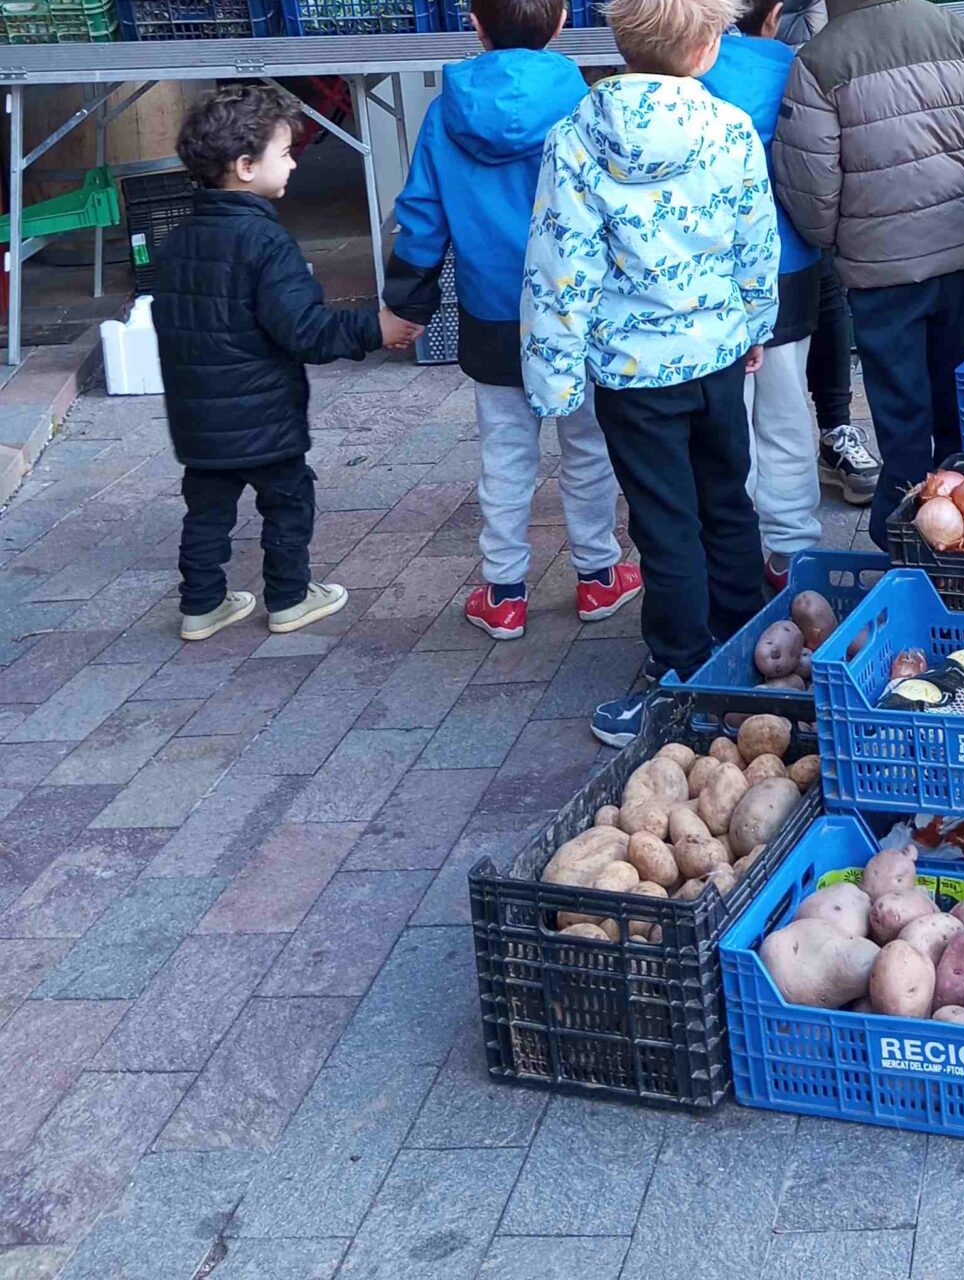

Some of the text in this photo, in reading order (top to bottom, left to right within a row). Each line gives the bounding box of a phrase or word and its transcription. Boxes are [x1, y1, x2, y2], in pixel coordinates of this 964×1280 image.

[881, 1059, 909, 1070] MERCAT
[910, 1061, 923, 1071] DEL
[923, 1062, 942, 1073] CAMP
